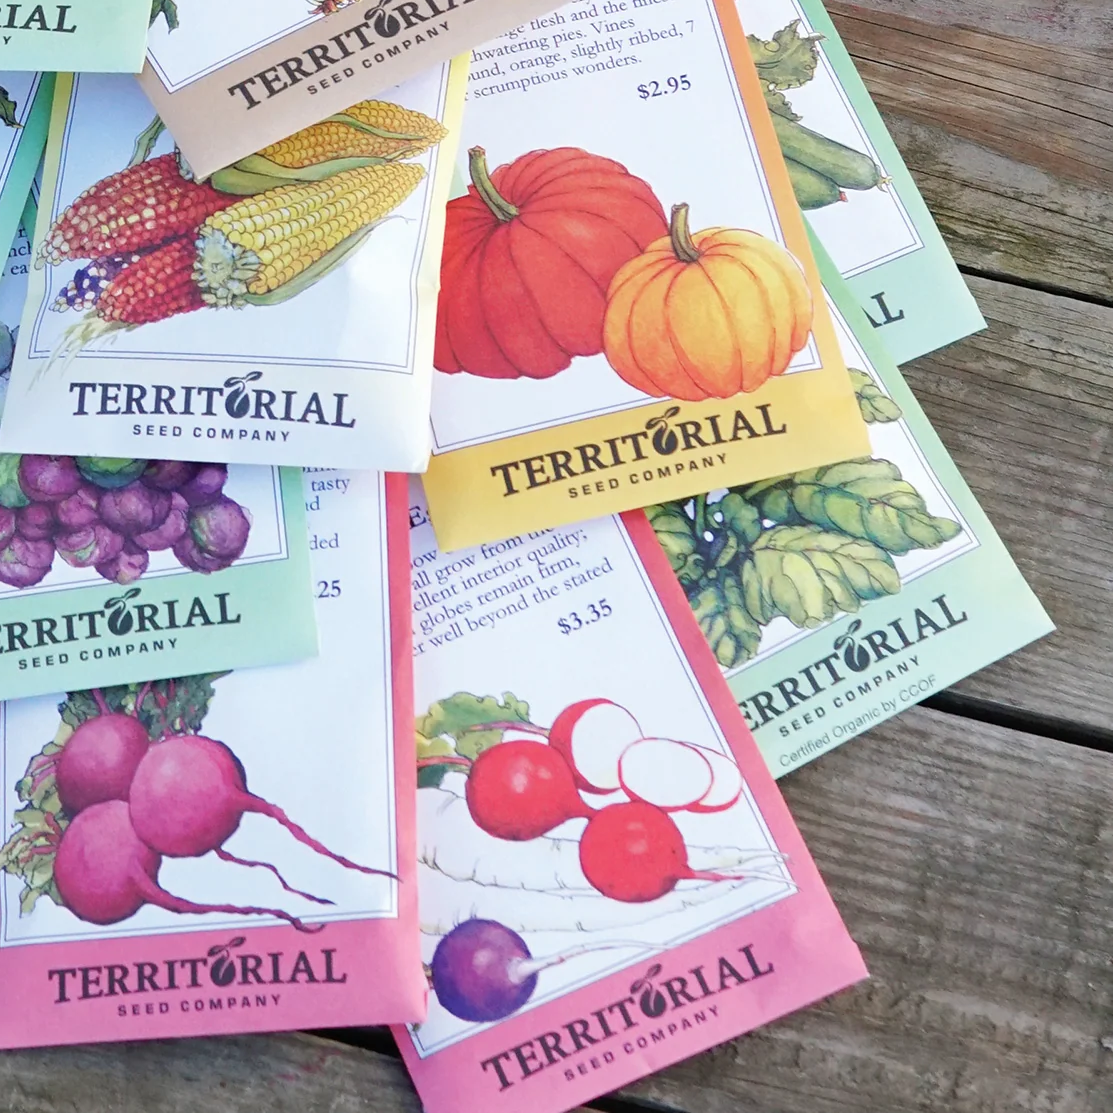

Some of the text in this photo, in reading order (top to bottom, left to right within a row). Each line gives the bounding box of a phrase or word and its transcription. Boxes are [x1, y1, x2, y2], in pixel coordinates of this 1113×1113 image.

[553, 17, 635, 46] pies. Vines
[570, 5, 599, 22] and
[307, 21, 450, 95] SEED COMPANY
[510, 25, 684, 72] orange, slightly ribbed,
[474, 57, 642, 98] scrumptious wonders.
[637, 74, 691, 100] $2.95
[69, 371, 356, 428] TERRITORIAL
[132, 424, 291, 441] SEED COMPANY
[490, 403, 786, 497] TERRITORIAL
[311, 478, 350, 494] tasty
[569, 453, 728, 498] SEED COMPANY
[435, 535, 523, 585] grow from
[463, 529, 588, 590] interior quality;
[419, 558, 581, 636] globes remain firm,
[429, 557, 614, 646] well beyond the stated
[557, 599, 612, 635] $3.35
[18, 638, 178, 670] SEED COMPANY
[779, 655, 920, 737] SEED COMPANY
[779, 675, 937, 767] Certified Organic by CCOF
[48, 936, 347, 1005] TERRITORIAL
[117, 994, 281, 1016] SEED COMPANY
[480, 943, 775, 1092] TERRITORIAL
[564, 1005, 719, 1082] SEED COMPANY
